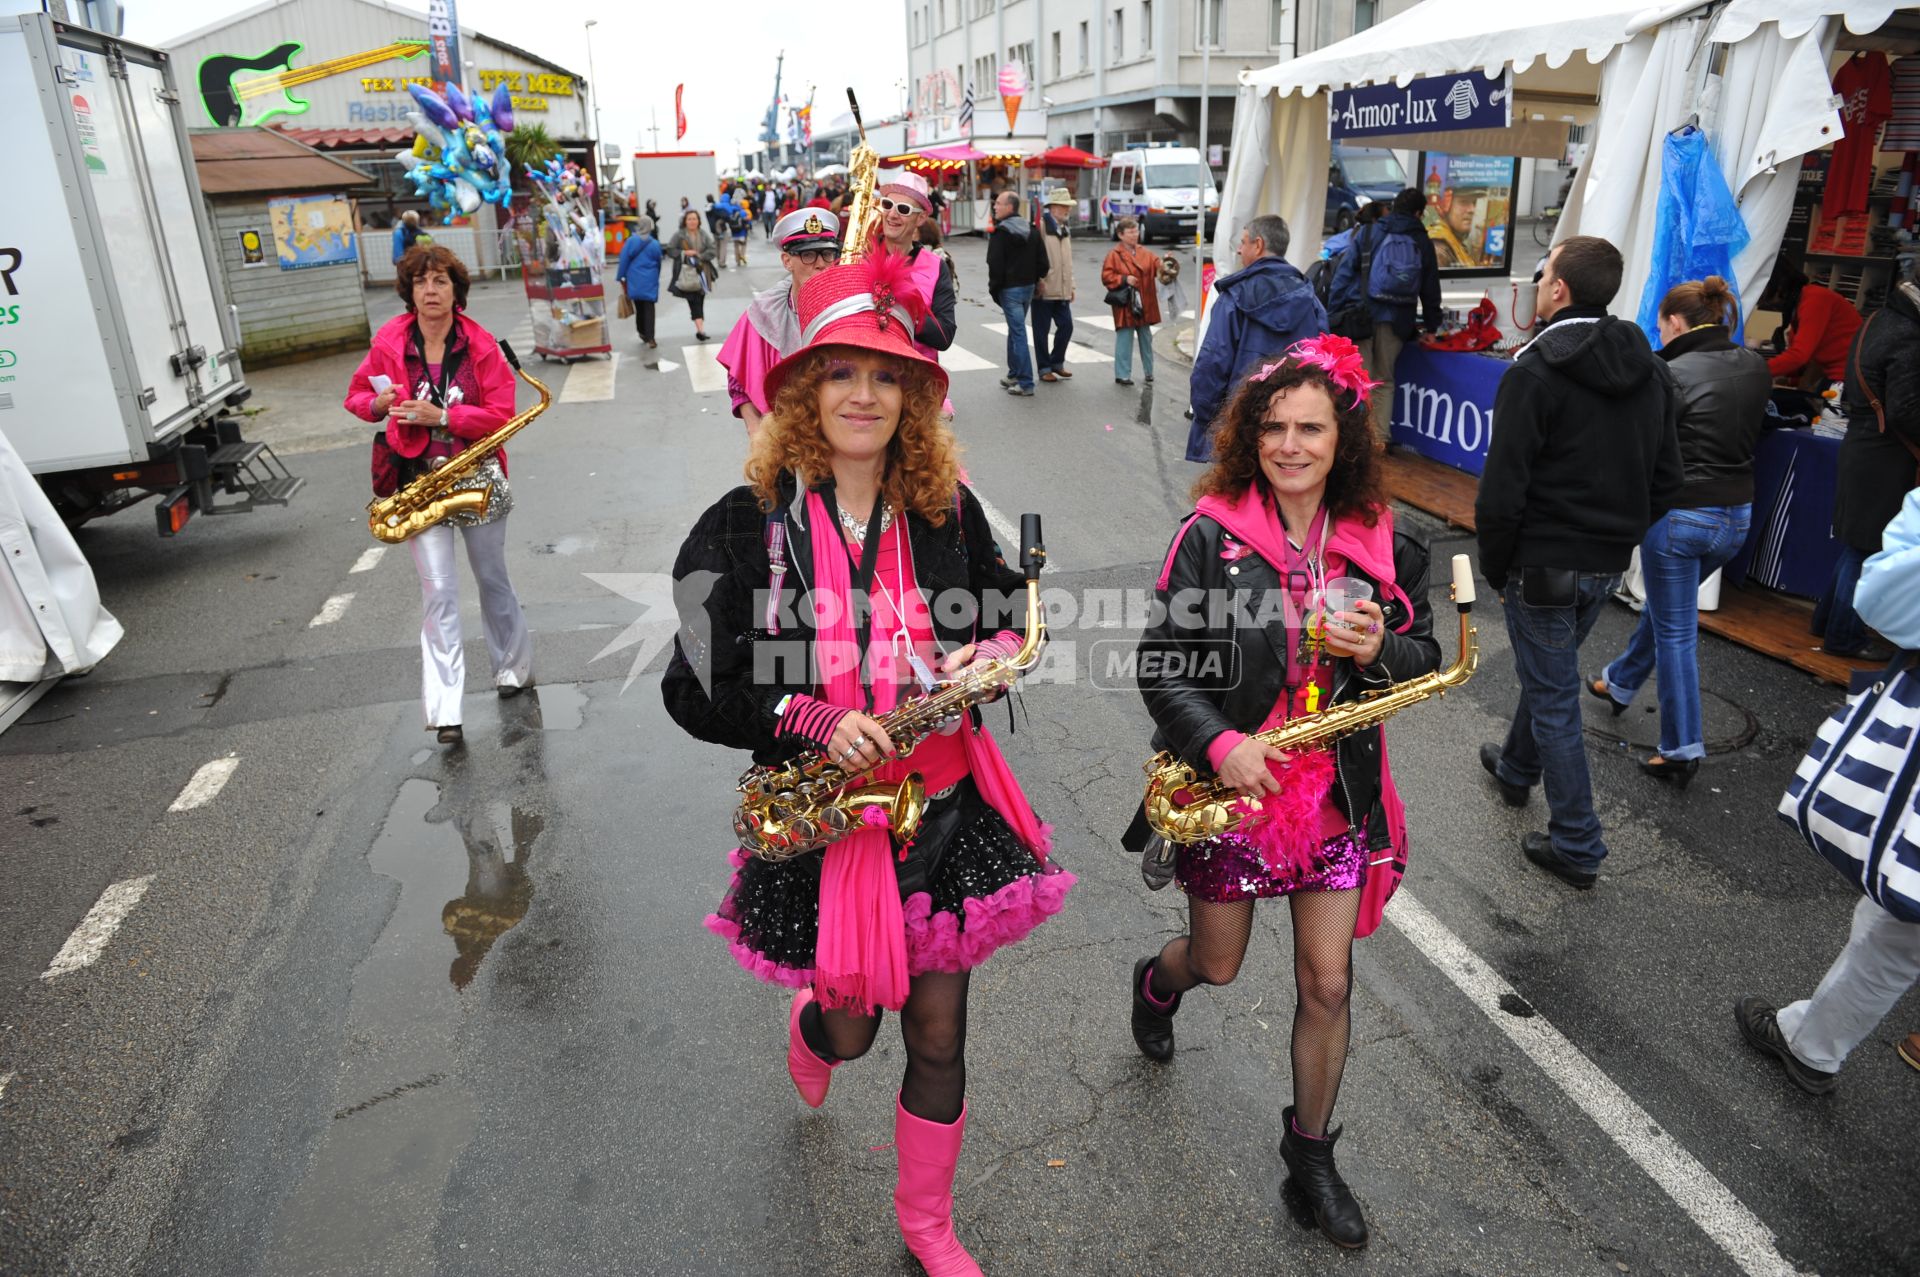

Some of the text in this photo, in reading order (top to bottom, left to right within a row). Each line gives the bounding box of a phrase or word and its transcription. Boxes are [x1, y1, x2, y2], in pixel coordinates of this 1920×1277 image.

[361, 78, 395, 92] TEX
[479, 70, 573, 95] TEX MEX
[349, 102, 416, 122] Resta
[511, 96, 549, 111] PIZZA
[1488, 229, 1505, 252] 3
[1392, 382, 1494, 457] rmo
